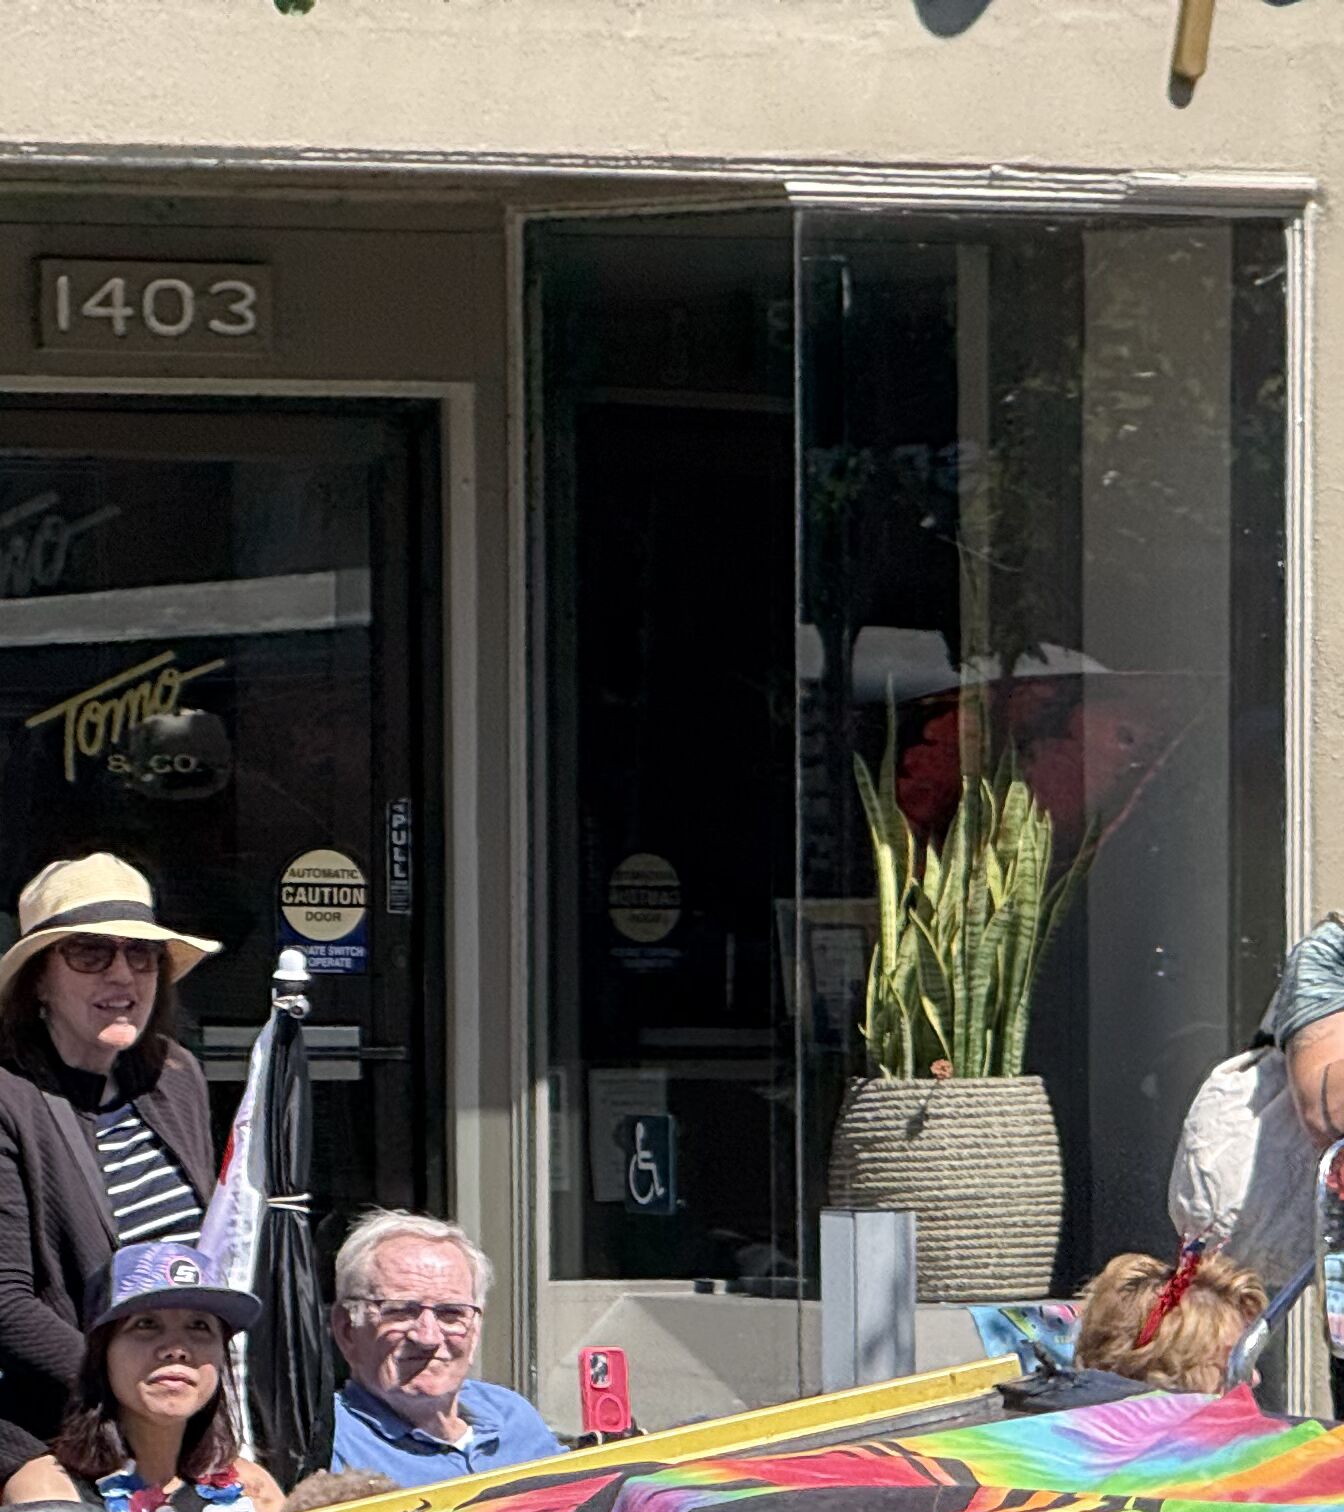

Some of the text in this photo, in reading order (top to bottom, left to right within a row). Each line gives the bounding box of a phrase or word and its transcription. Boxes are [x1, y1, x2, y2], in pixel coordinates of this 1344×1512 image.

[56, 275, 257, 337] 1403
[25, 650, 225, 782] Tomo
[391, 814, 407, 879] PULL
[288, 868, 360, 880] AUTOMATIC
[281, 886, 366, 905] CAUTION
[304, 911, 342, 922] DOOR
[327, 945, 365, 957] SWITCH
[308, 957, 353, 968] OPERATE
